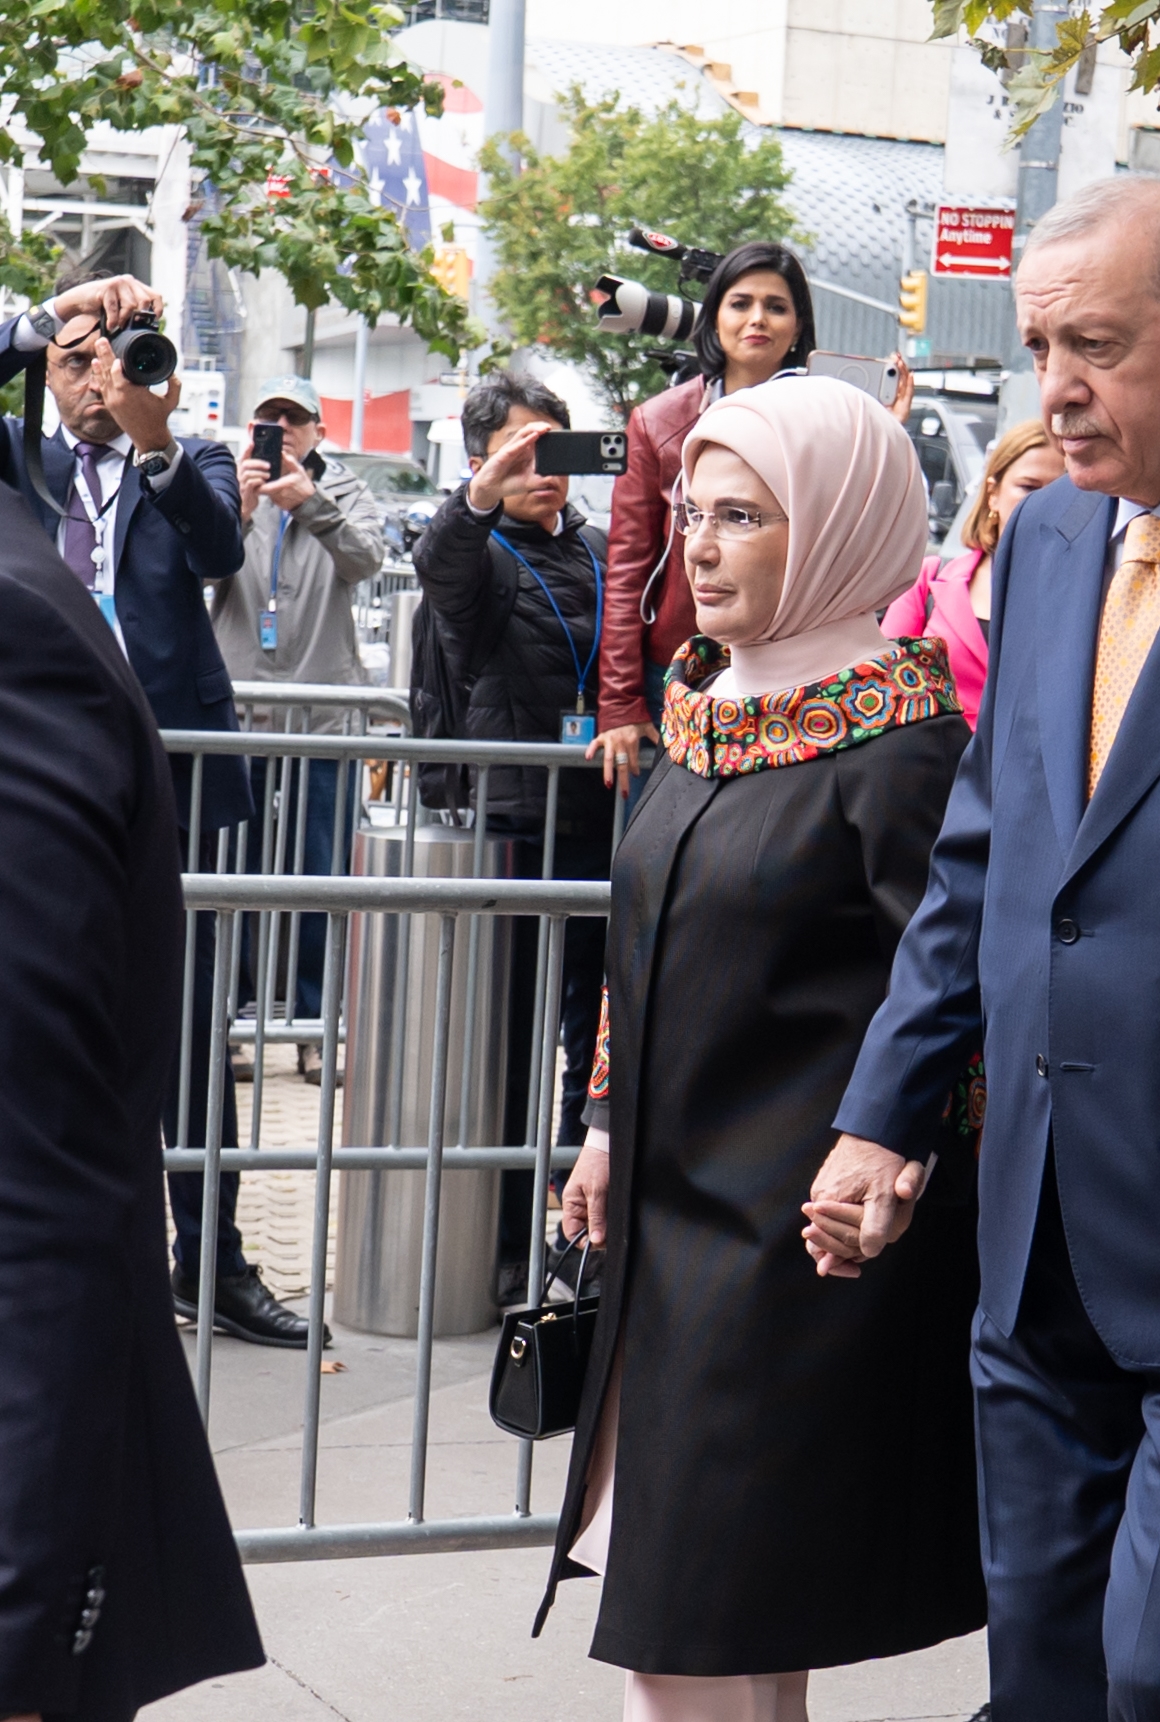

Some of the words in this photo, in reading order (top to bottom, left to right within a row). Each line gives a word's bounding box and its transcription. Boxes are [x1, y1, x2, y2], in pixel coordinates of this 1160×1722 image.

[940, 211, 960, 227] NO
[962, 213, 1015, 230] STOPPIN
[940, 227, 993, 245] Anytime
